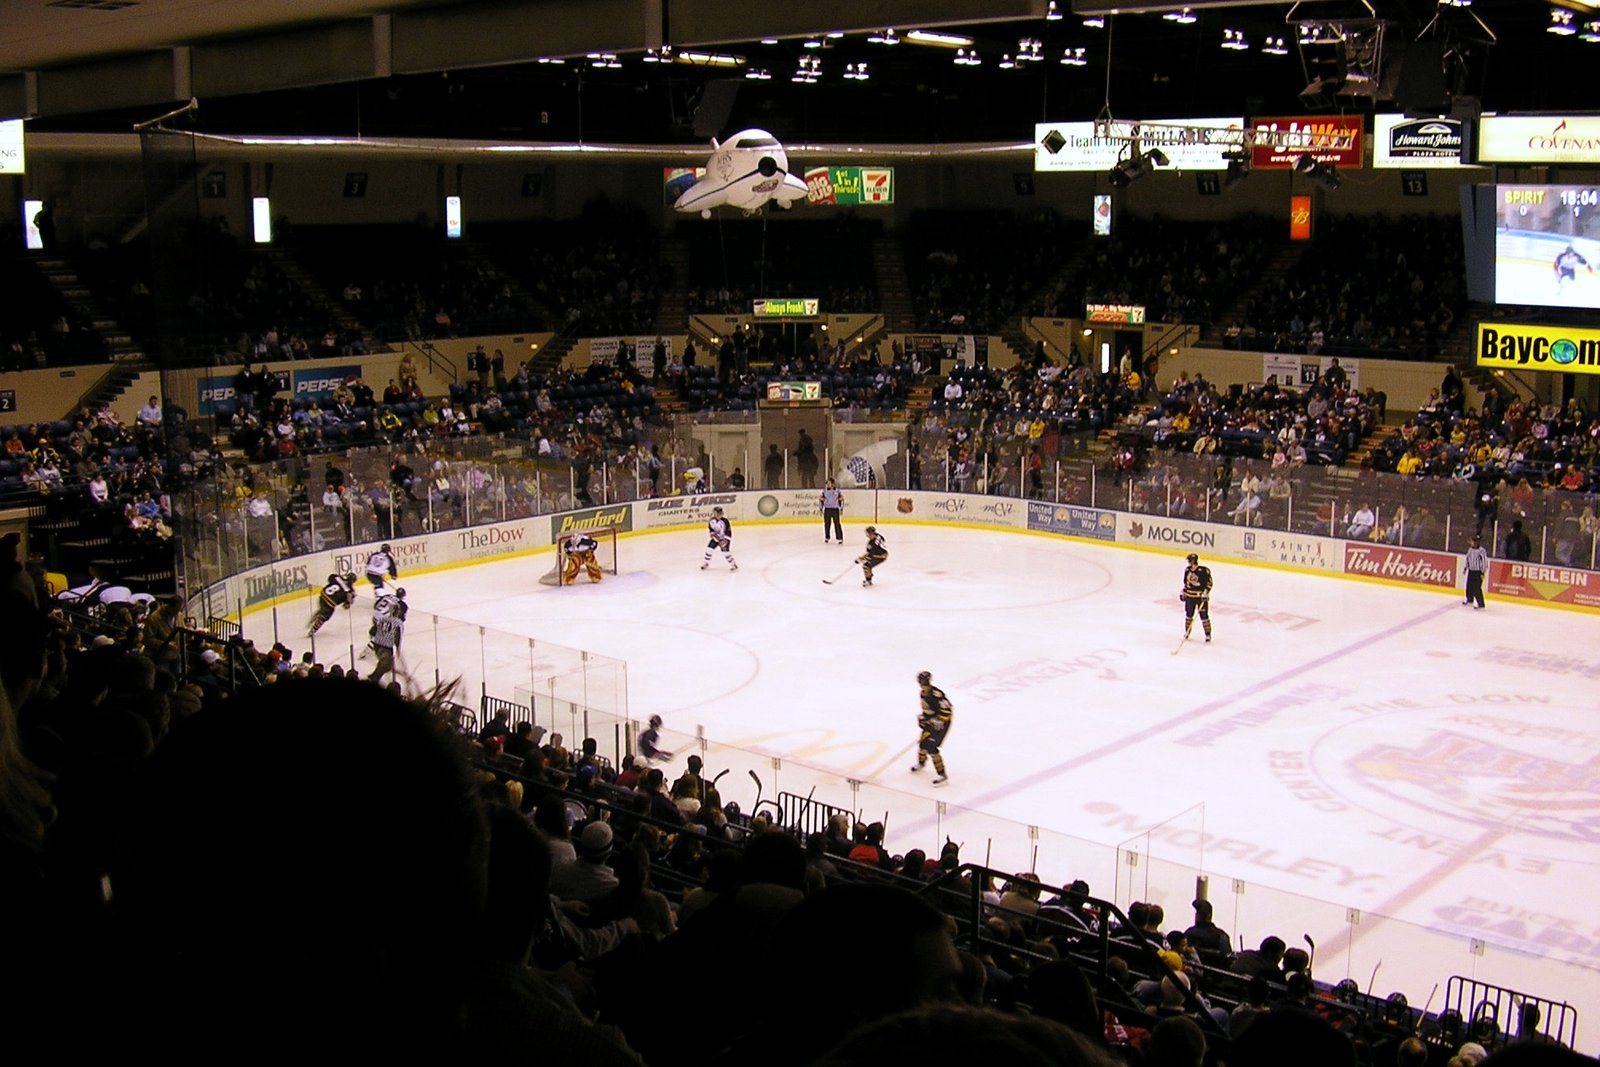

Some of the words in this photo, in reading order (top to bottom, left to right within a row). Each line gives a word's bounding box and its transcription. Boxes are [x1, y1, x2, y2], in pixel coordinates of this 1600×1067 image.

[1070, 135, 1100, 147] Team
[1395, 134, 1433, 146] Howard
[1433, 134, 1461, 147] Johns
[807, 177, 828, 191] BIG
[866, 175, 887, 187] 7
[351, 182, 359, 194] 3
[1203, 183, 1215, 195] 11
[1408, 182, 1422, 196] 13
[1504, 190, 1545, 205] SPIRIT
[1520, 205, 1527, 216] 0
[1574, 206, 1579, 217] 1
[1305, 371, 1316, 382] 13
[280, 378, 285, 389] 1
[202, 388, 236, 402] PEP
[2, 398, 9, 409] 2
[658, 508, 700, 517] CHARTERS
[1029, 503, 1053, 514] United
[1072, 509, 1097, 520] United
[1038, 514, 1053, 526] Way
[1081, 519, 1097, 531] Way
[1147, 525, 1215, 548] MOLSON
[1271, 540, 1312, 553] SAINT
[1347, 549, 1379, 573] Tim
[1381, 552, 1452, 584] Hortons
[1511, 564, 1588, 587] BIERLEIN
[244, 564, 308, 603] Timbers
[1448, 692, 1553, 706] DOW
